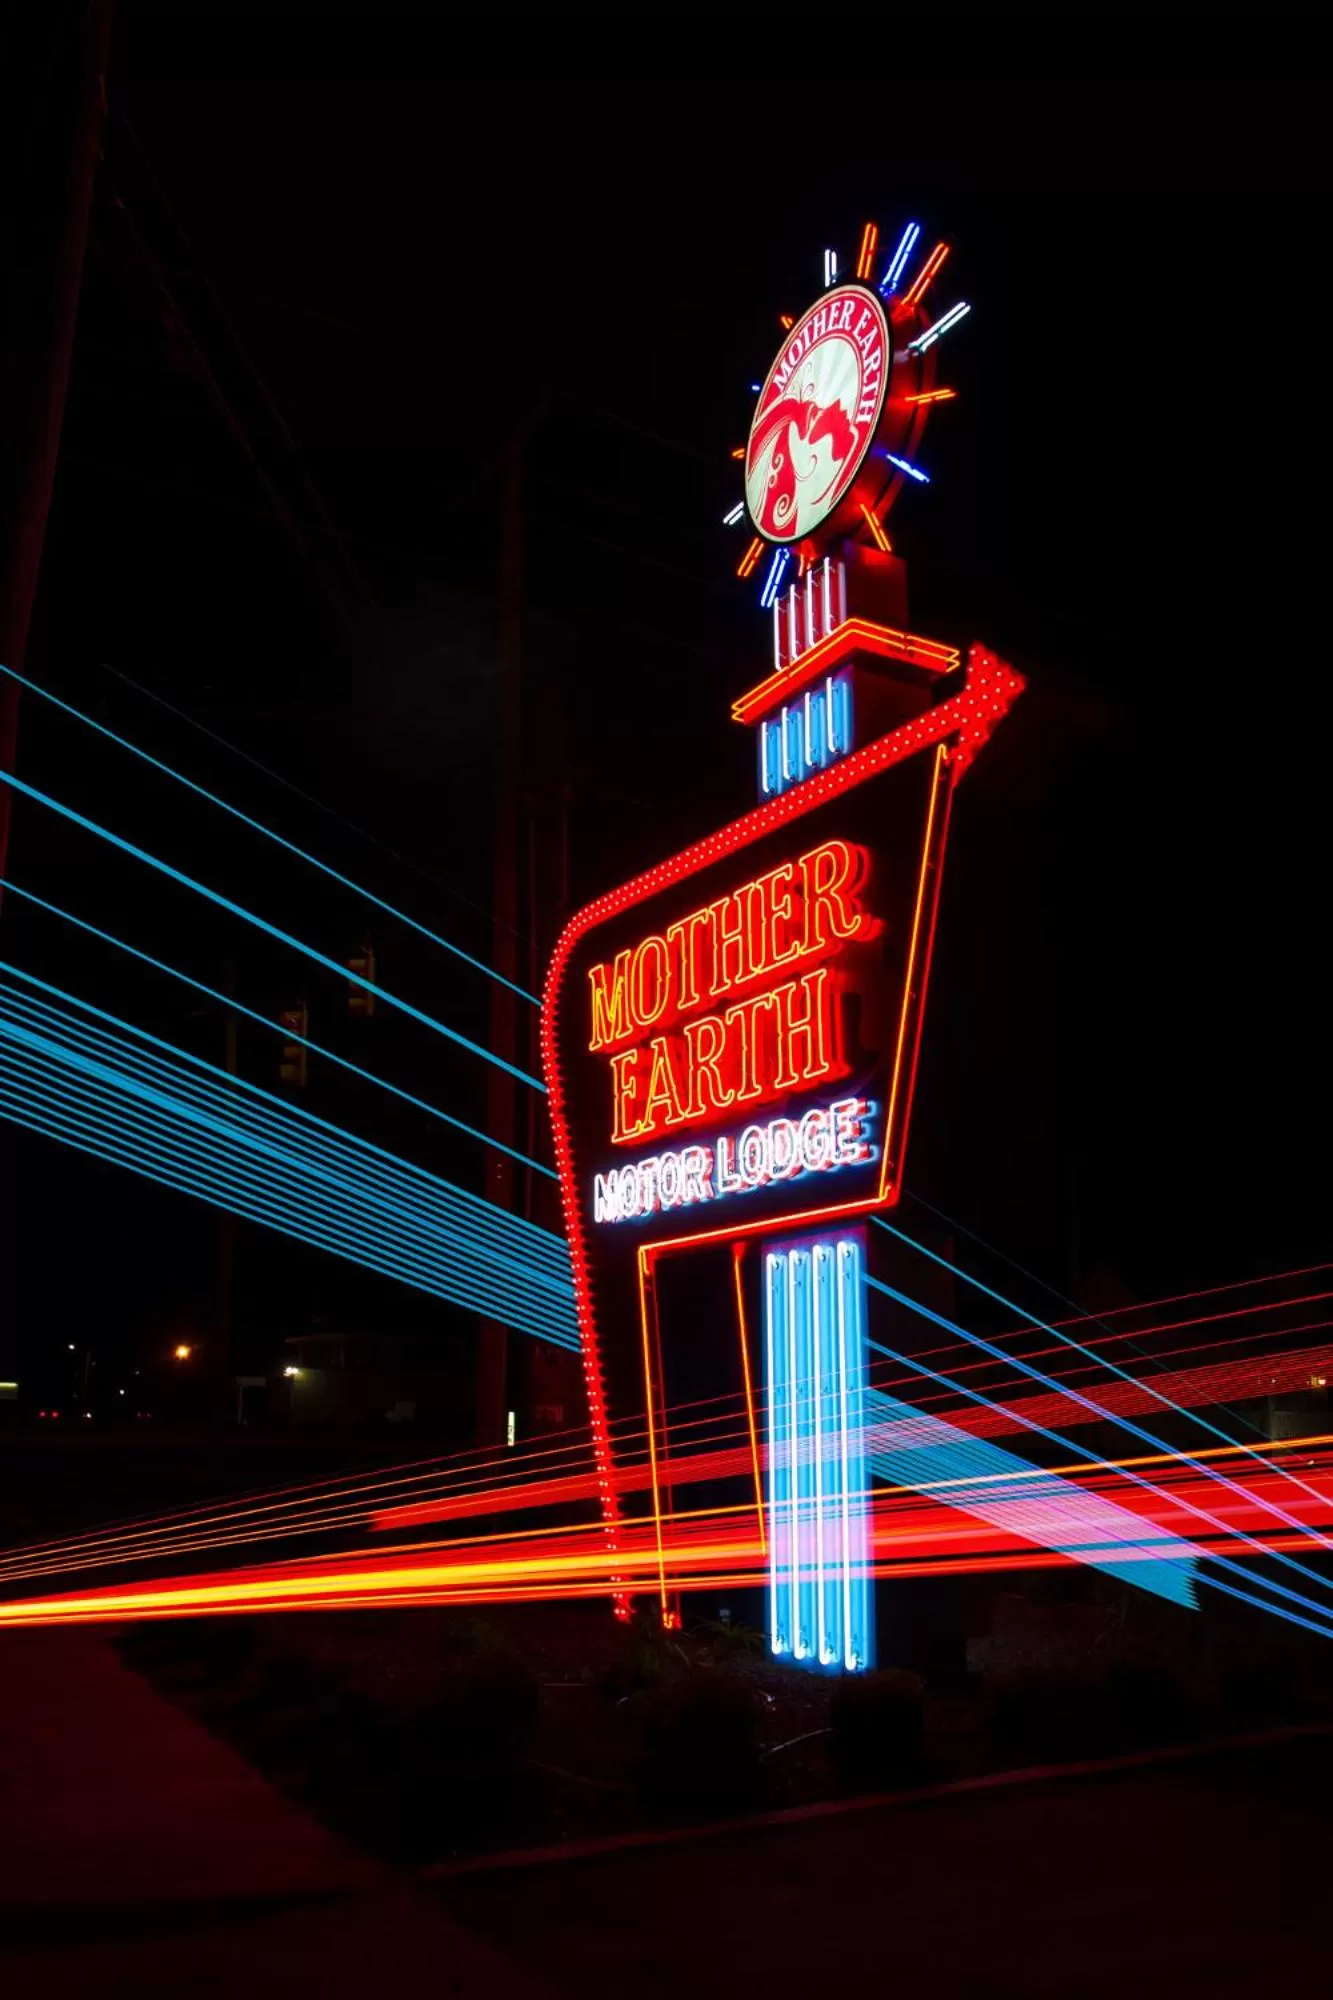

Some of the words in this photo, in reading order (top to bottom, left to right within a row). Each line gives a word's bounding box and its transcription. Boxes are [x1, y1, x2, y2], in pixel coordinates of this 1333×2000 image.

[773, 301, 855, 392] MOTHER
[853, 309, 881, 424] EARTH
[588, 841, 863, 1052] MOTHER
[610, 968, 829, 1144] EARTH
[594, 1145, 714, 1222] MOTOR
[718, 1097, 860, 1193] LODGE
